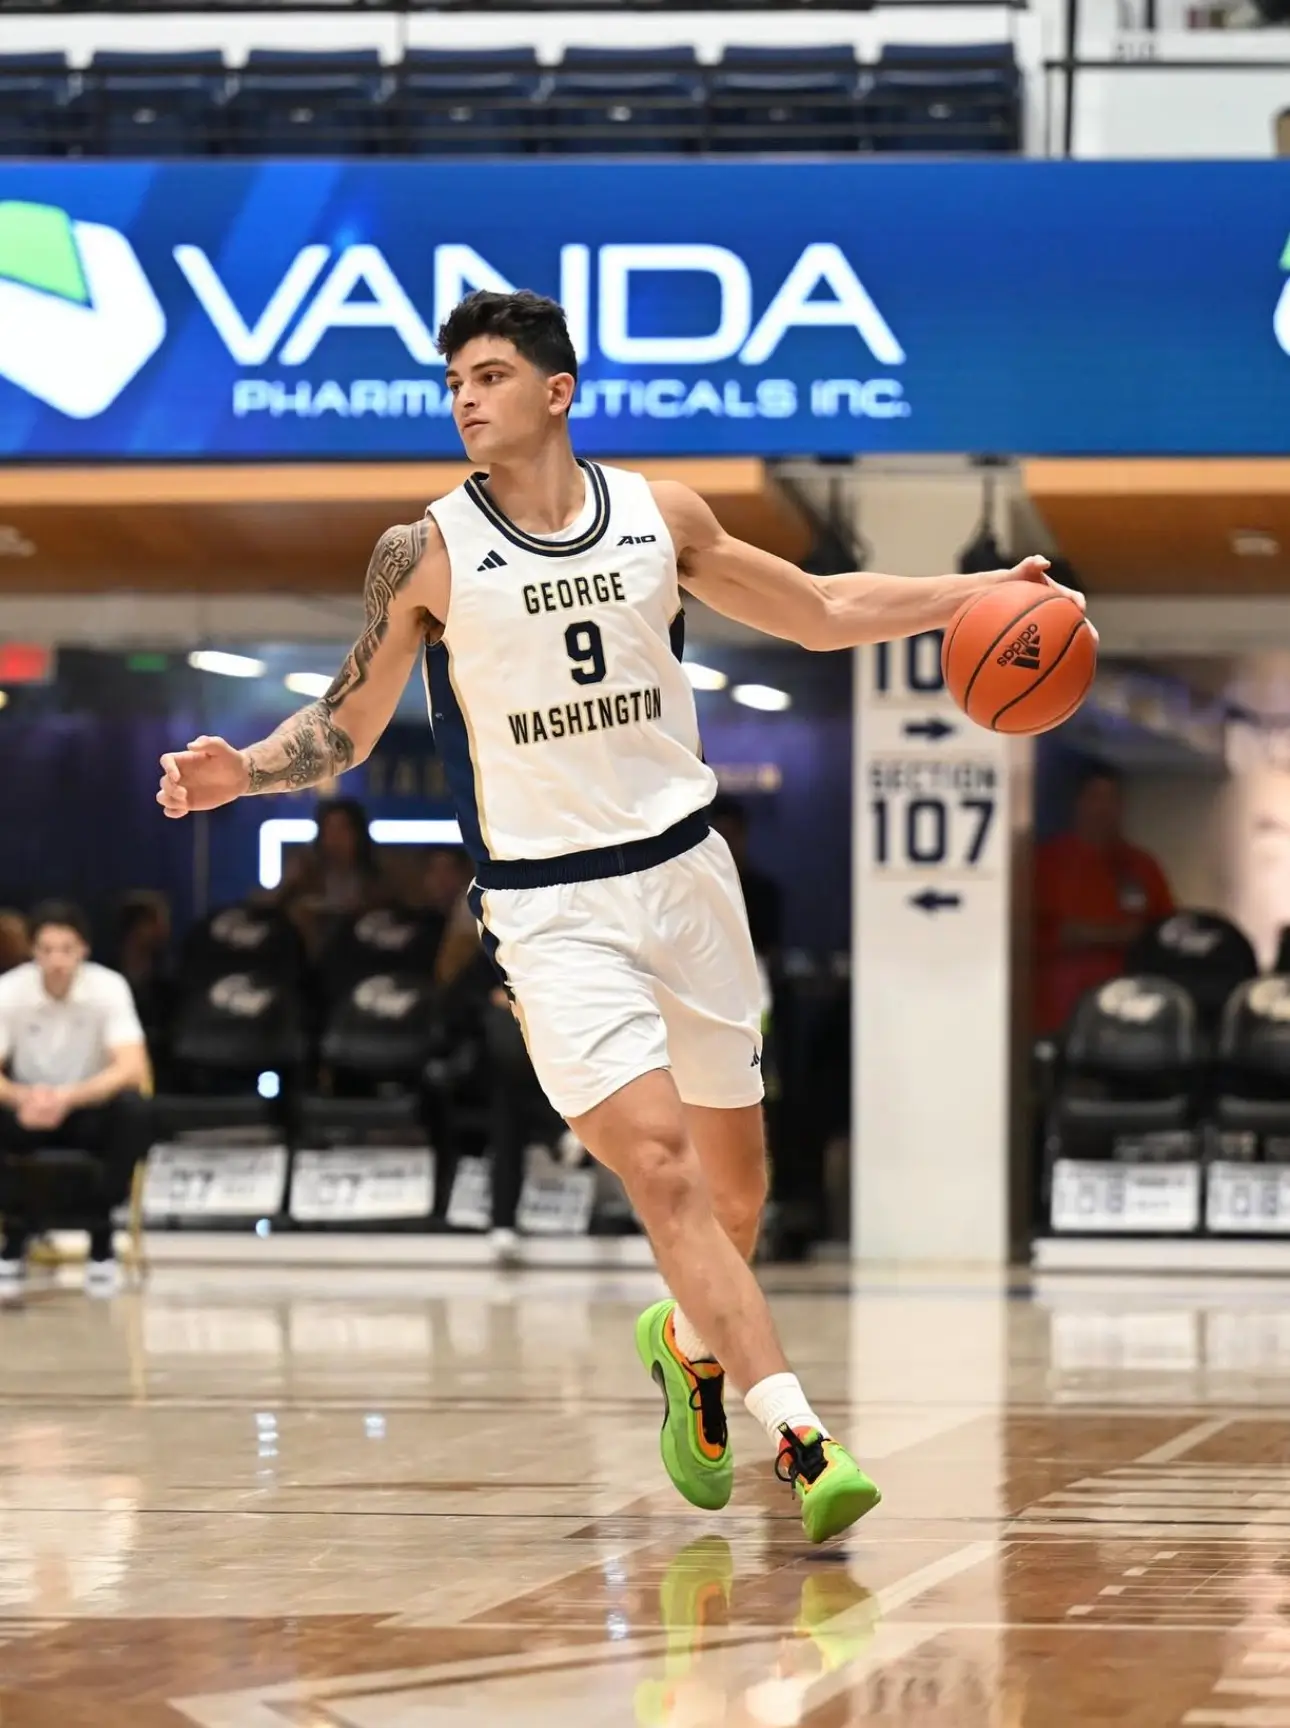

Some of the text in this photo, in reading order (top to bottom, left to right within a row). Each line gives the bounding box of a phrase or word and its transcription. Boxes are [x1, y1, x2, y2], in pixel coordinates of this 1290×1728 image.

[172, 243, 907, 367] VANDA
[810, 379, 912, 418] INC.
[616, 534, 657, 547] A10
[522, 572, 626, 615] GEORGE
[564, 620, 607, 686] 9
[873, 628, 946, 693] 10
[996, 623, 1038, 667] adidas
[507, 686, 662, 745] WASHINGTON
[870, 761, 997, 790] SECTION
[873, 797, 995, 865] 107
